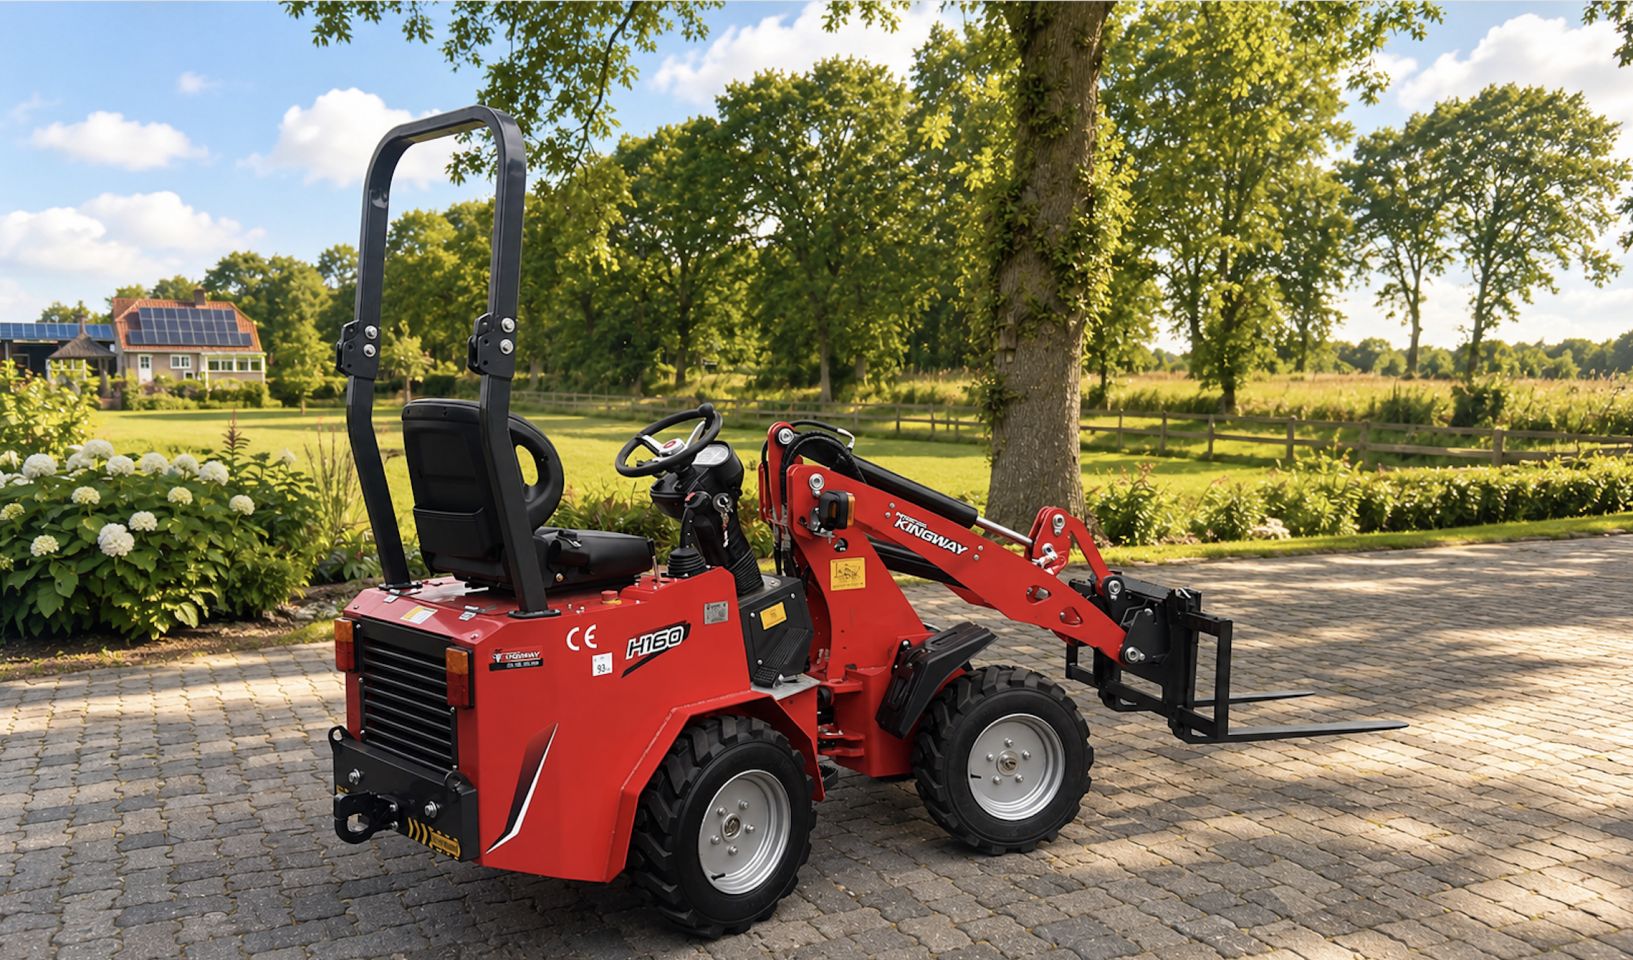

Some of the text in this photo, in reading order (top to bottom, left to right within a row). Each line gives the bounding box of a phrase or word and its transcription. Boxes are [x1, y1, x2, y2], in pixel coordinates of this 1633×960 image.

[894, 519, 969, 555] KINGWAY
[566, 624, 598, 651] CE
[625, 625, 684, 660] H160
[597, 663, 606, 674] 93
